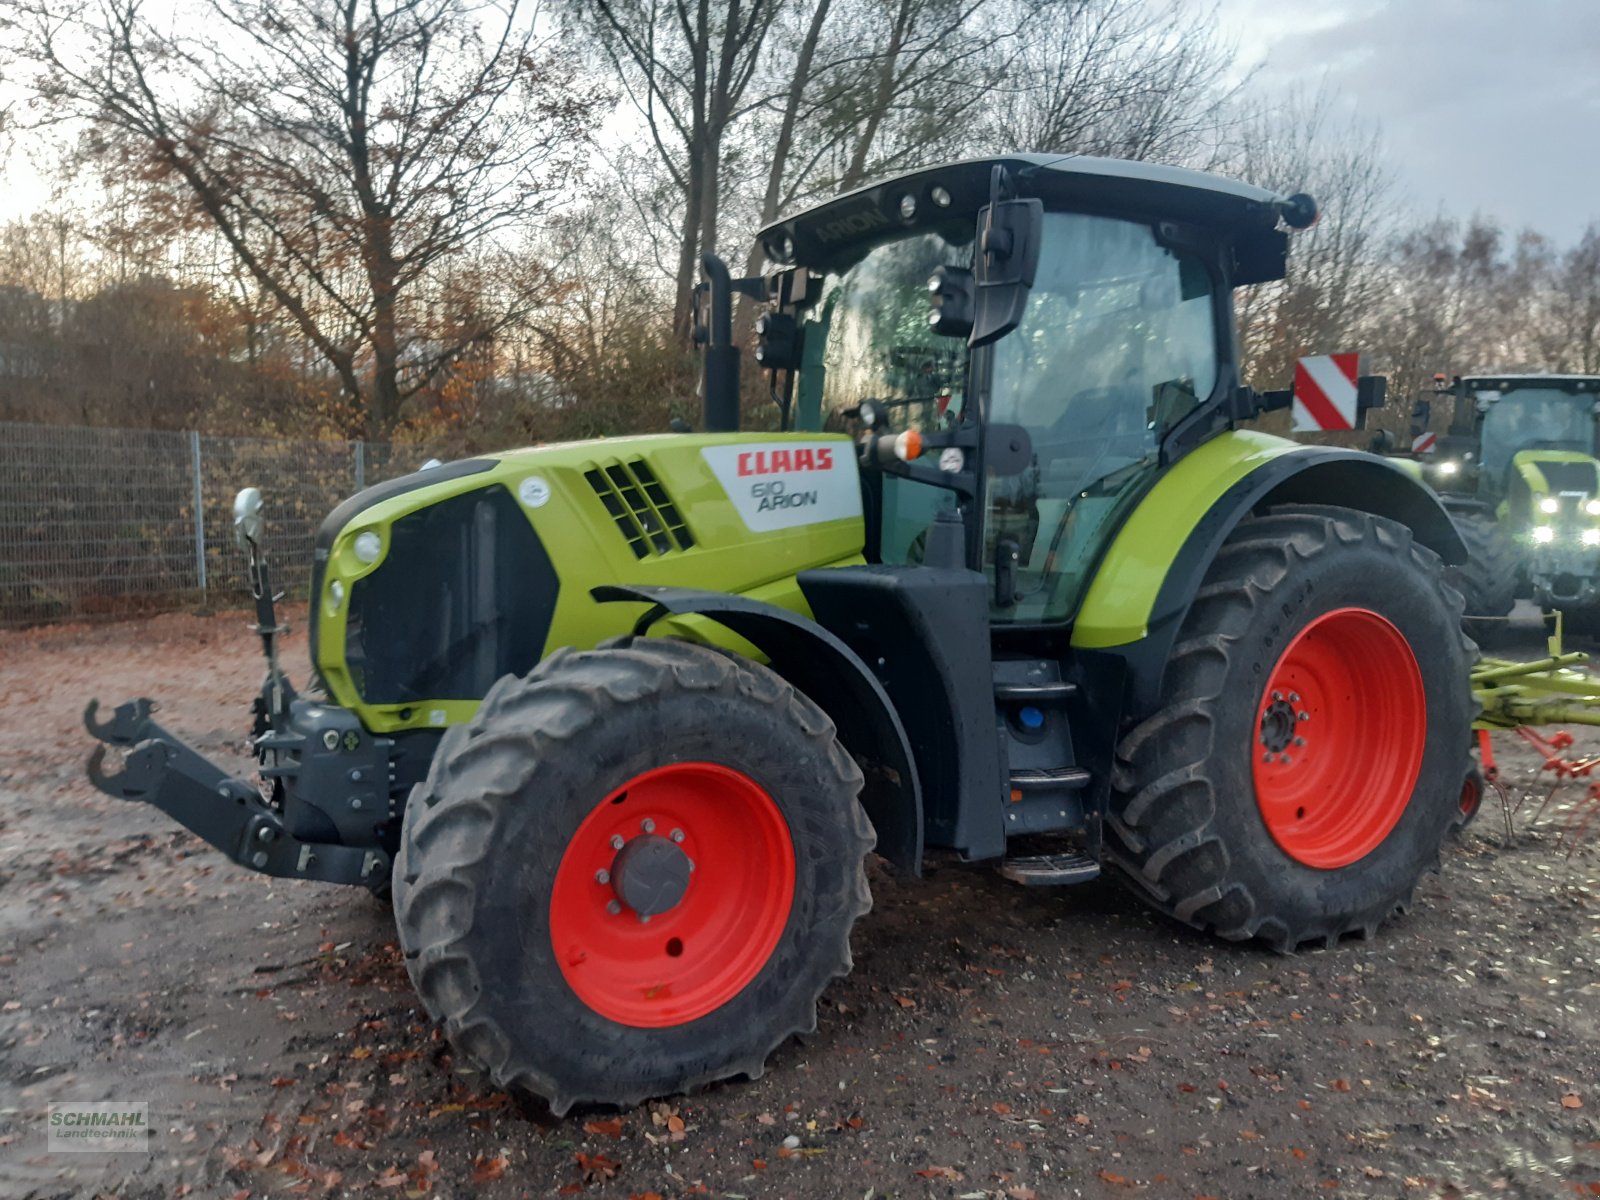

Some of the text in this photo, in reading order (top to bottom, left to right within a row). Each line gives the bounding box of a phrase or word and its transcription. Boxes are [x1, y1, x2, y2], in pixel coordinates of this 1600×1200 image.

[816, 208, 889, 243] ARION
[737, 448, 833, 477] CLAAS
[752, 480, 785, 498] 610
[757, 490, 818, 513] ARION
